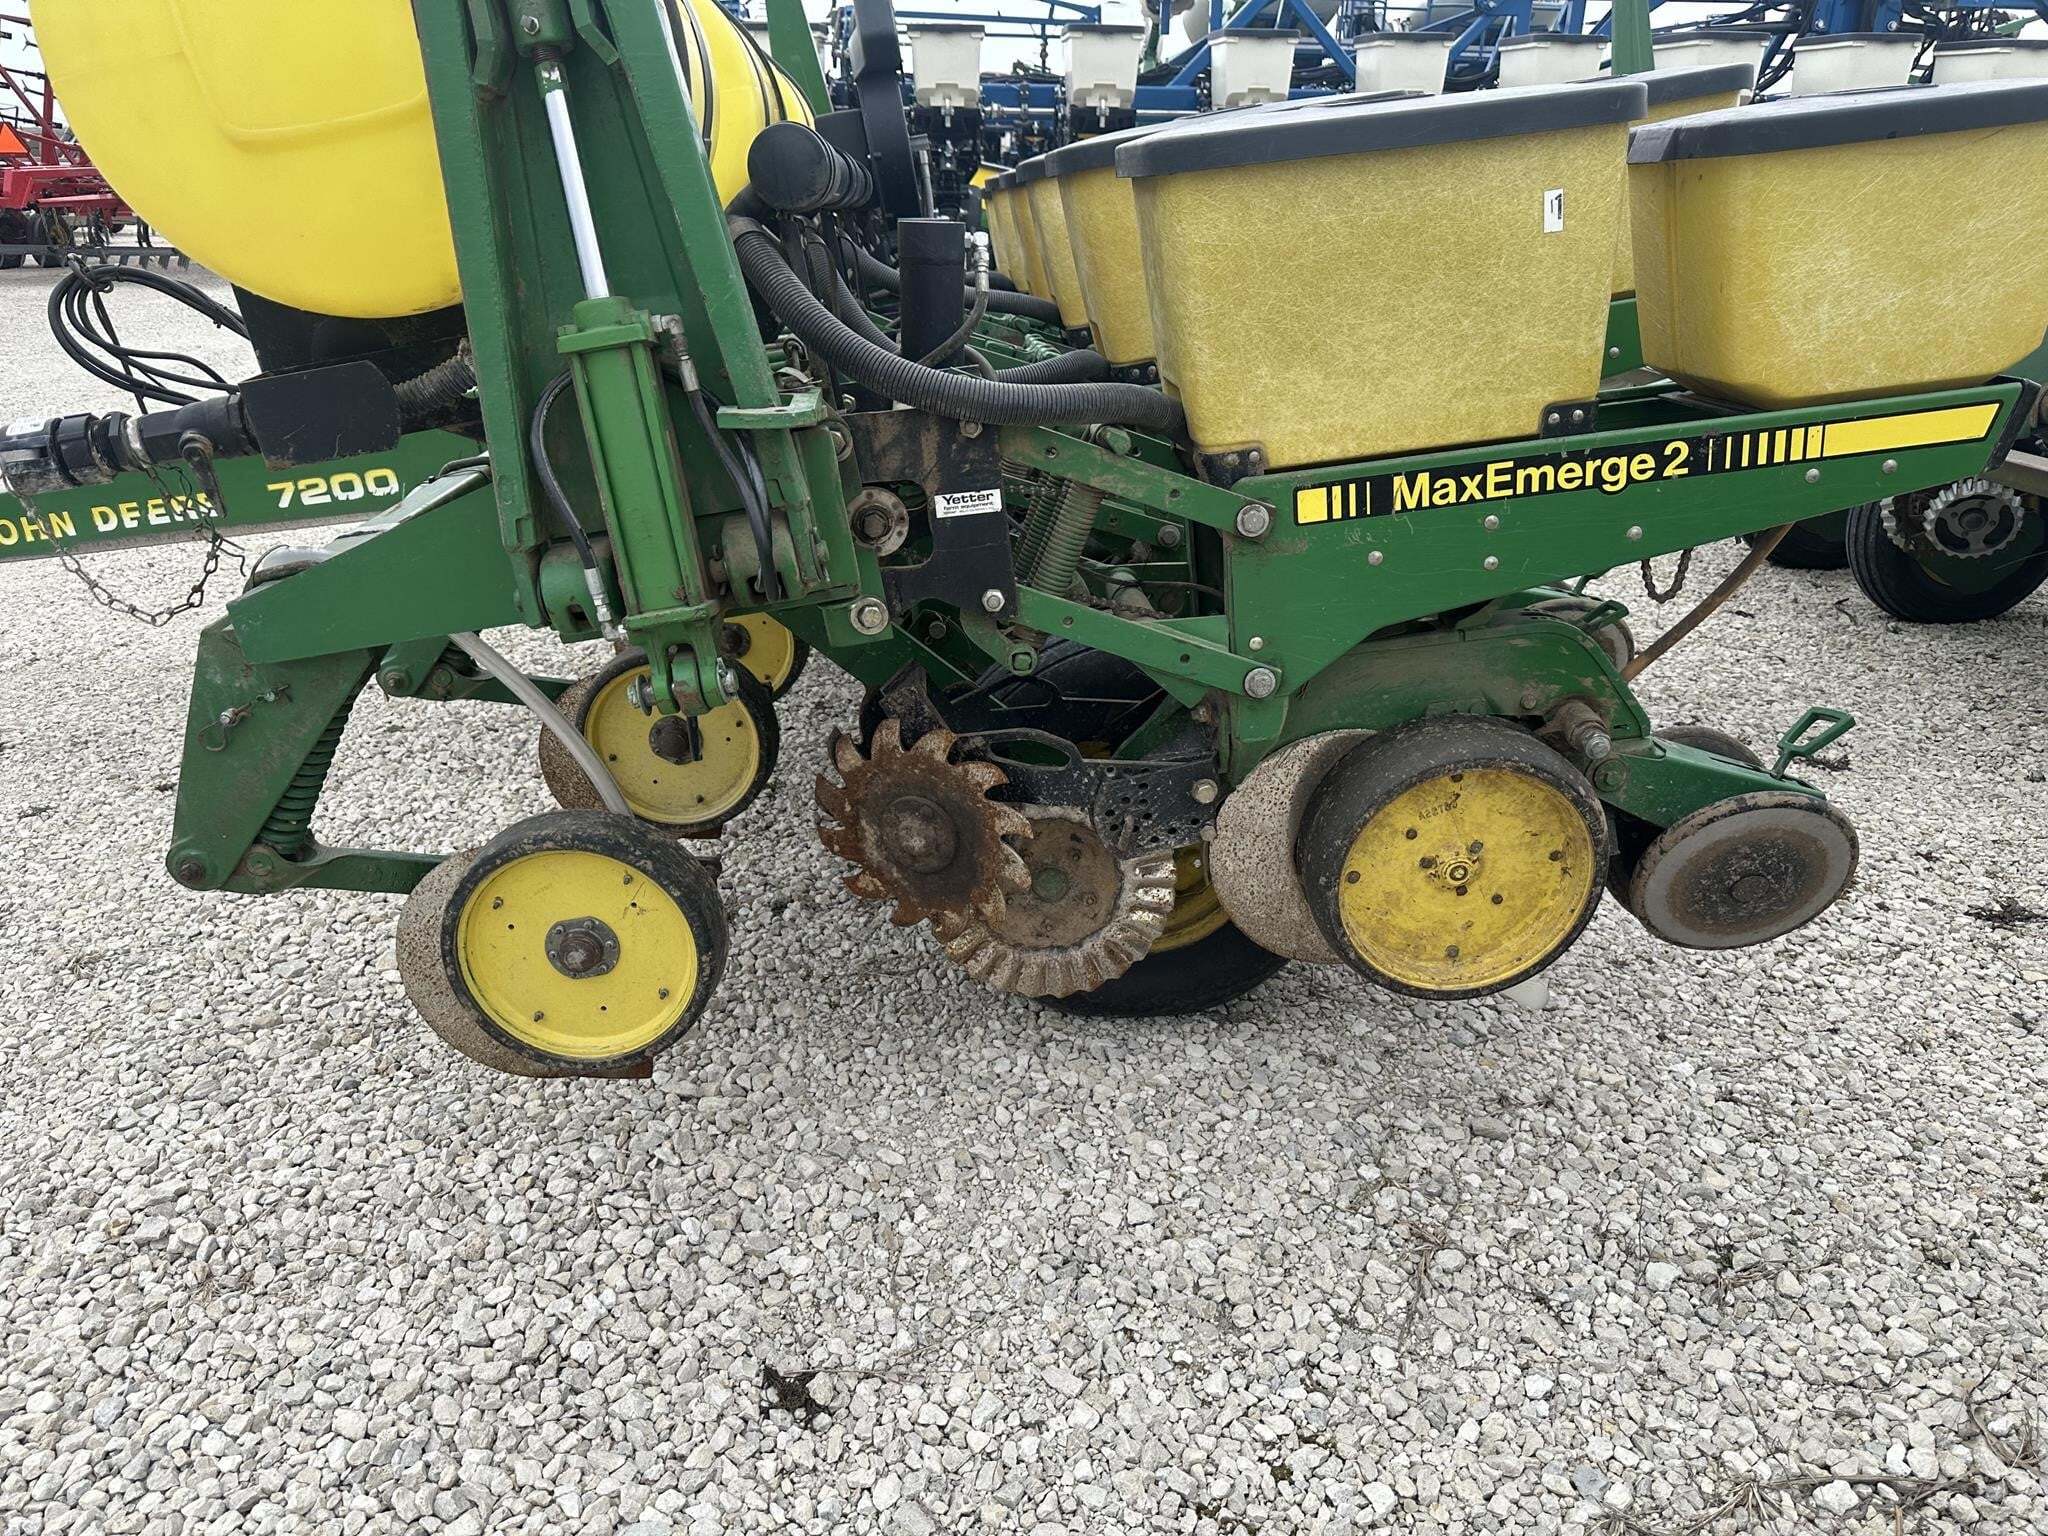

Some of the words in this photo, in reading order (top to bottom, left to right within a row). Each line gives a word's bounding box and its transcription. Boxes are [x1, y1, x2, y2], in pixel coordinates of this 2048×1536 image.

[267, 468, 400, 509] 7200
[1392, 451, 1656, 512] MaxEmerge
[1662, 440, 1690, 477] 2
[941, 492, 994, 505] Yetter
[0, 511, 77, 546] OHN
